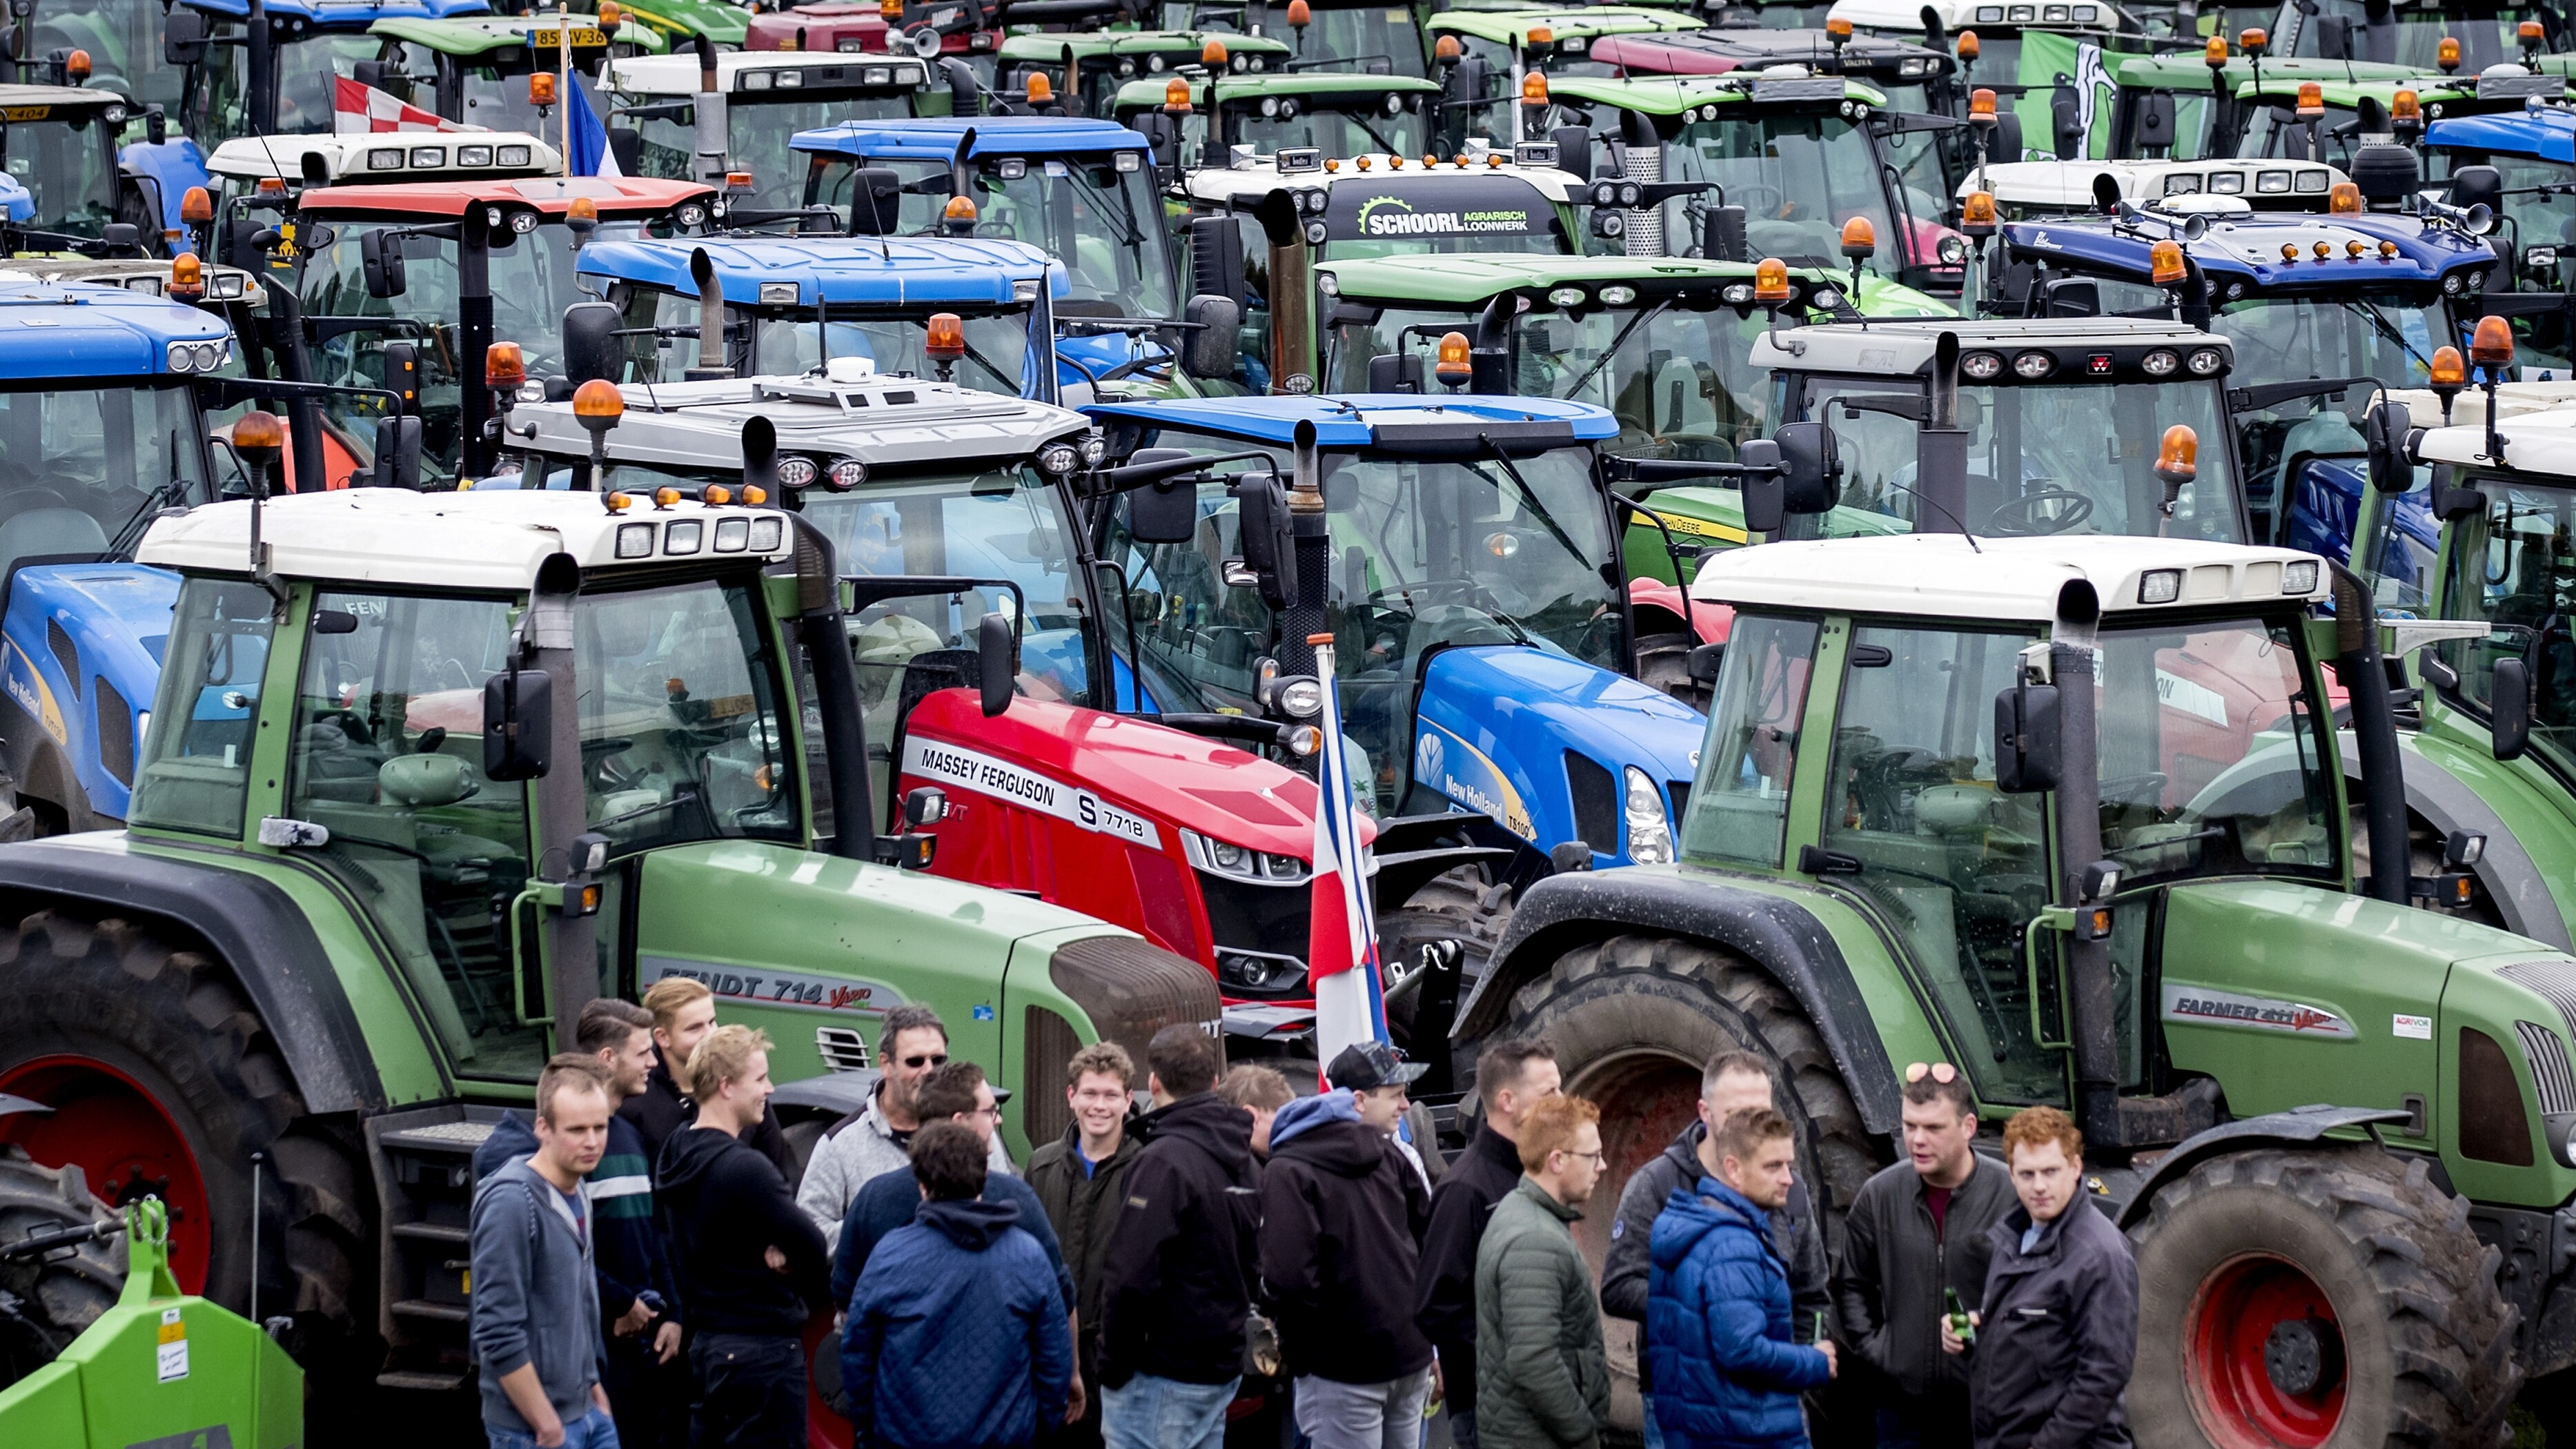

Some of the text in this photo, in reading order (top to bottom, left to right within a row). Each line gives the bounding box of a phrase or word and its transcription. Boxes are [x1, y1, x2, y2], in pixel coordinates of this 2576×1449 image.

[1369, 213, 1464, 235] SCHOORL
[1464, 210, 1526, 221] AGRARISCH
[1464, 220, 1528, 231] LOONWERK
[1660, 516, 1700, 533] OHN DEERE
[921, 748, 1143, 837] MASSEY FERGUSON S 7718
[1446, 773, 1502, 821] New Holland
[774, 978, 823, 1004] 714
[2176, 997, 2260, 1020] FARMER
[2396, 1017, 2429, 1027] AGRIVOR
